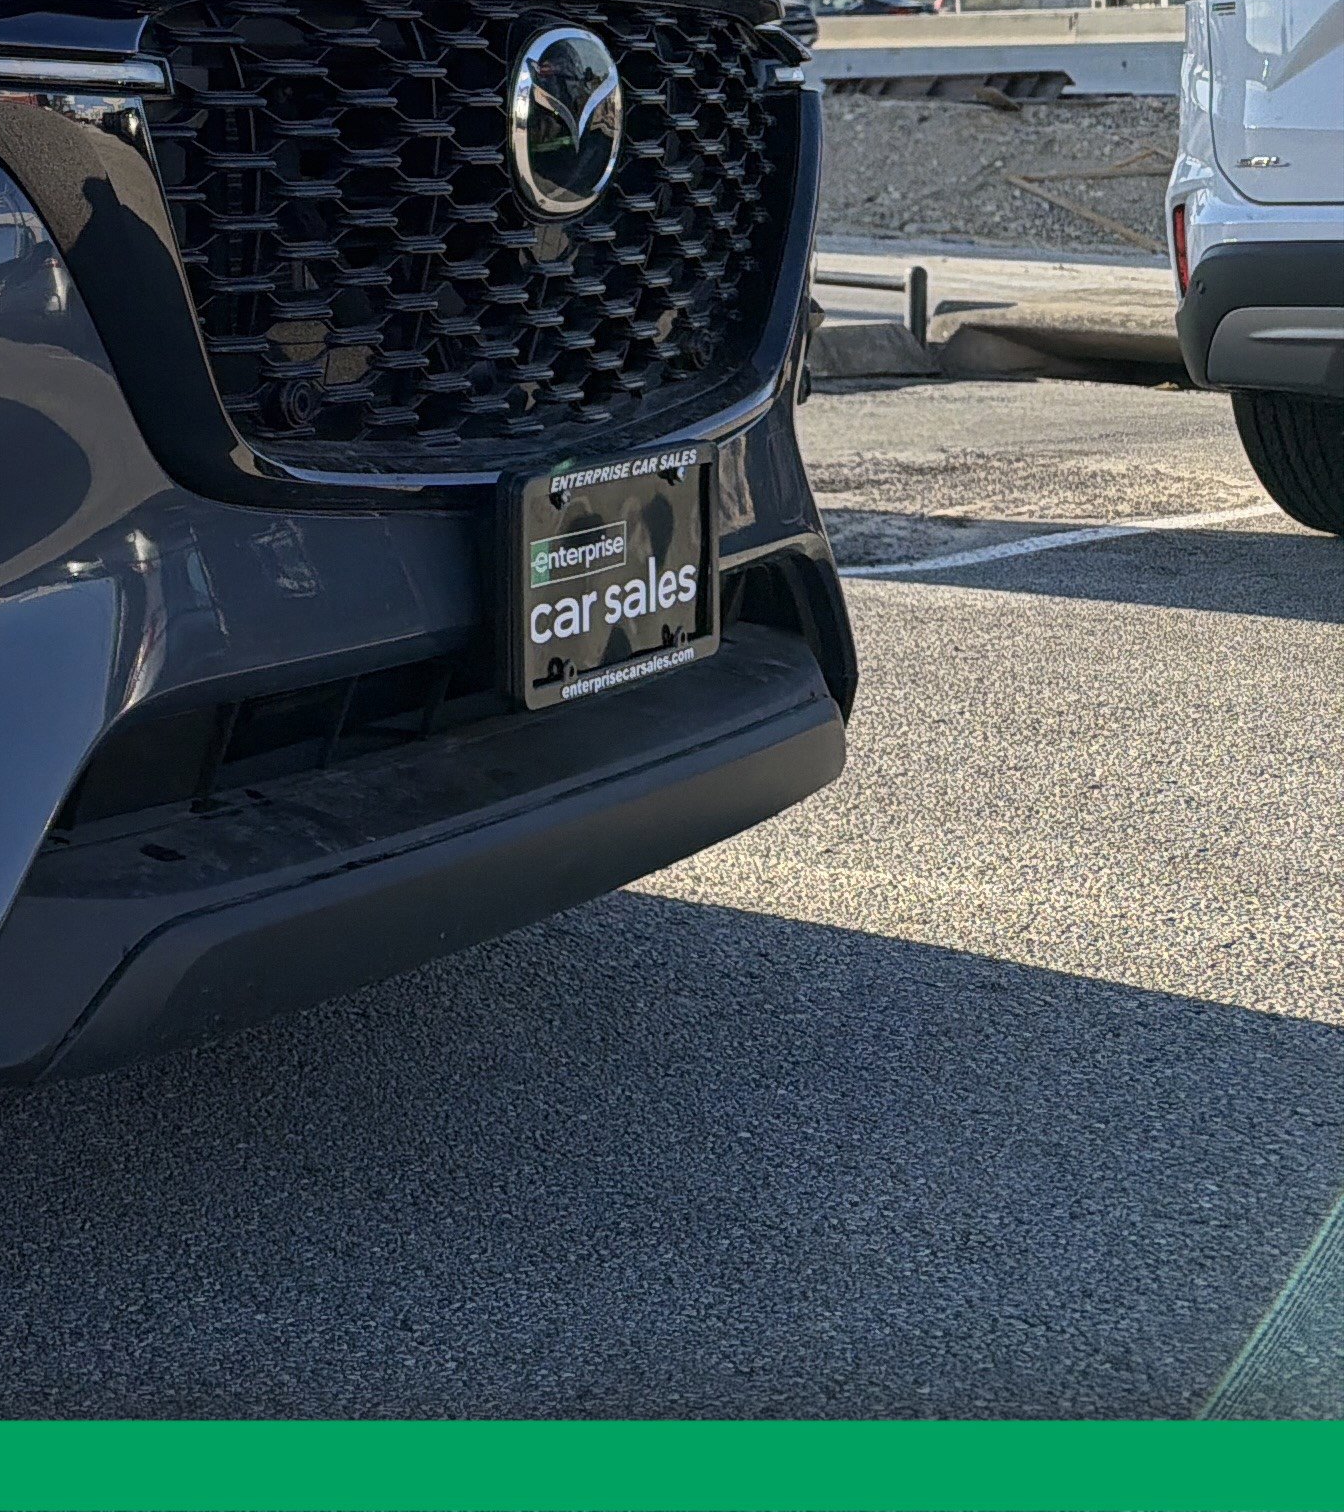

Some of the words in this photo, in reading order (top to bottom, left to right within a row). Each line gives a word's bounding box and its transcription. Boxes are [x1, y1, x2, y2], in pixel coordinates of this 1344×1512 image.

[550, 461, 630, 493] ENTERPRISE
[632, 456, 659, 475] CAR
[660, 448, 698, 468] SALES
[534, 533, 624, 574] enterprise
[530, 590, 598, 645] car
[604, 556, 698, 625] sales
[561, 646, 695, 700] enterprisecarsales.com
